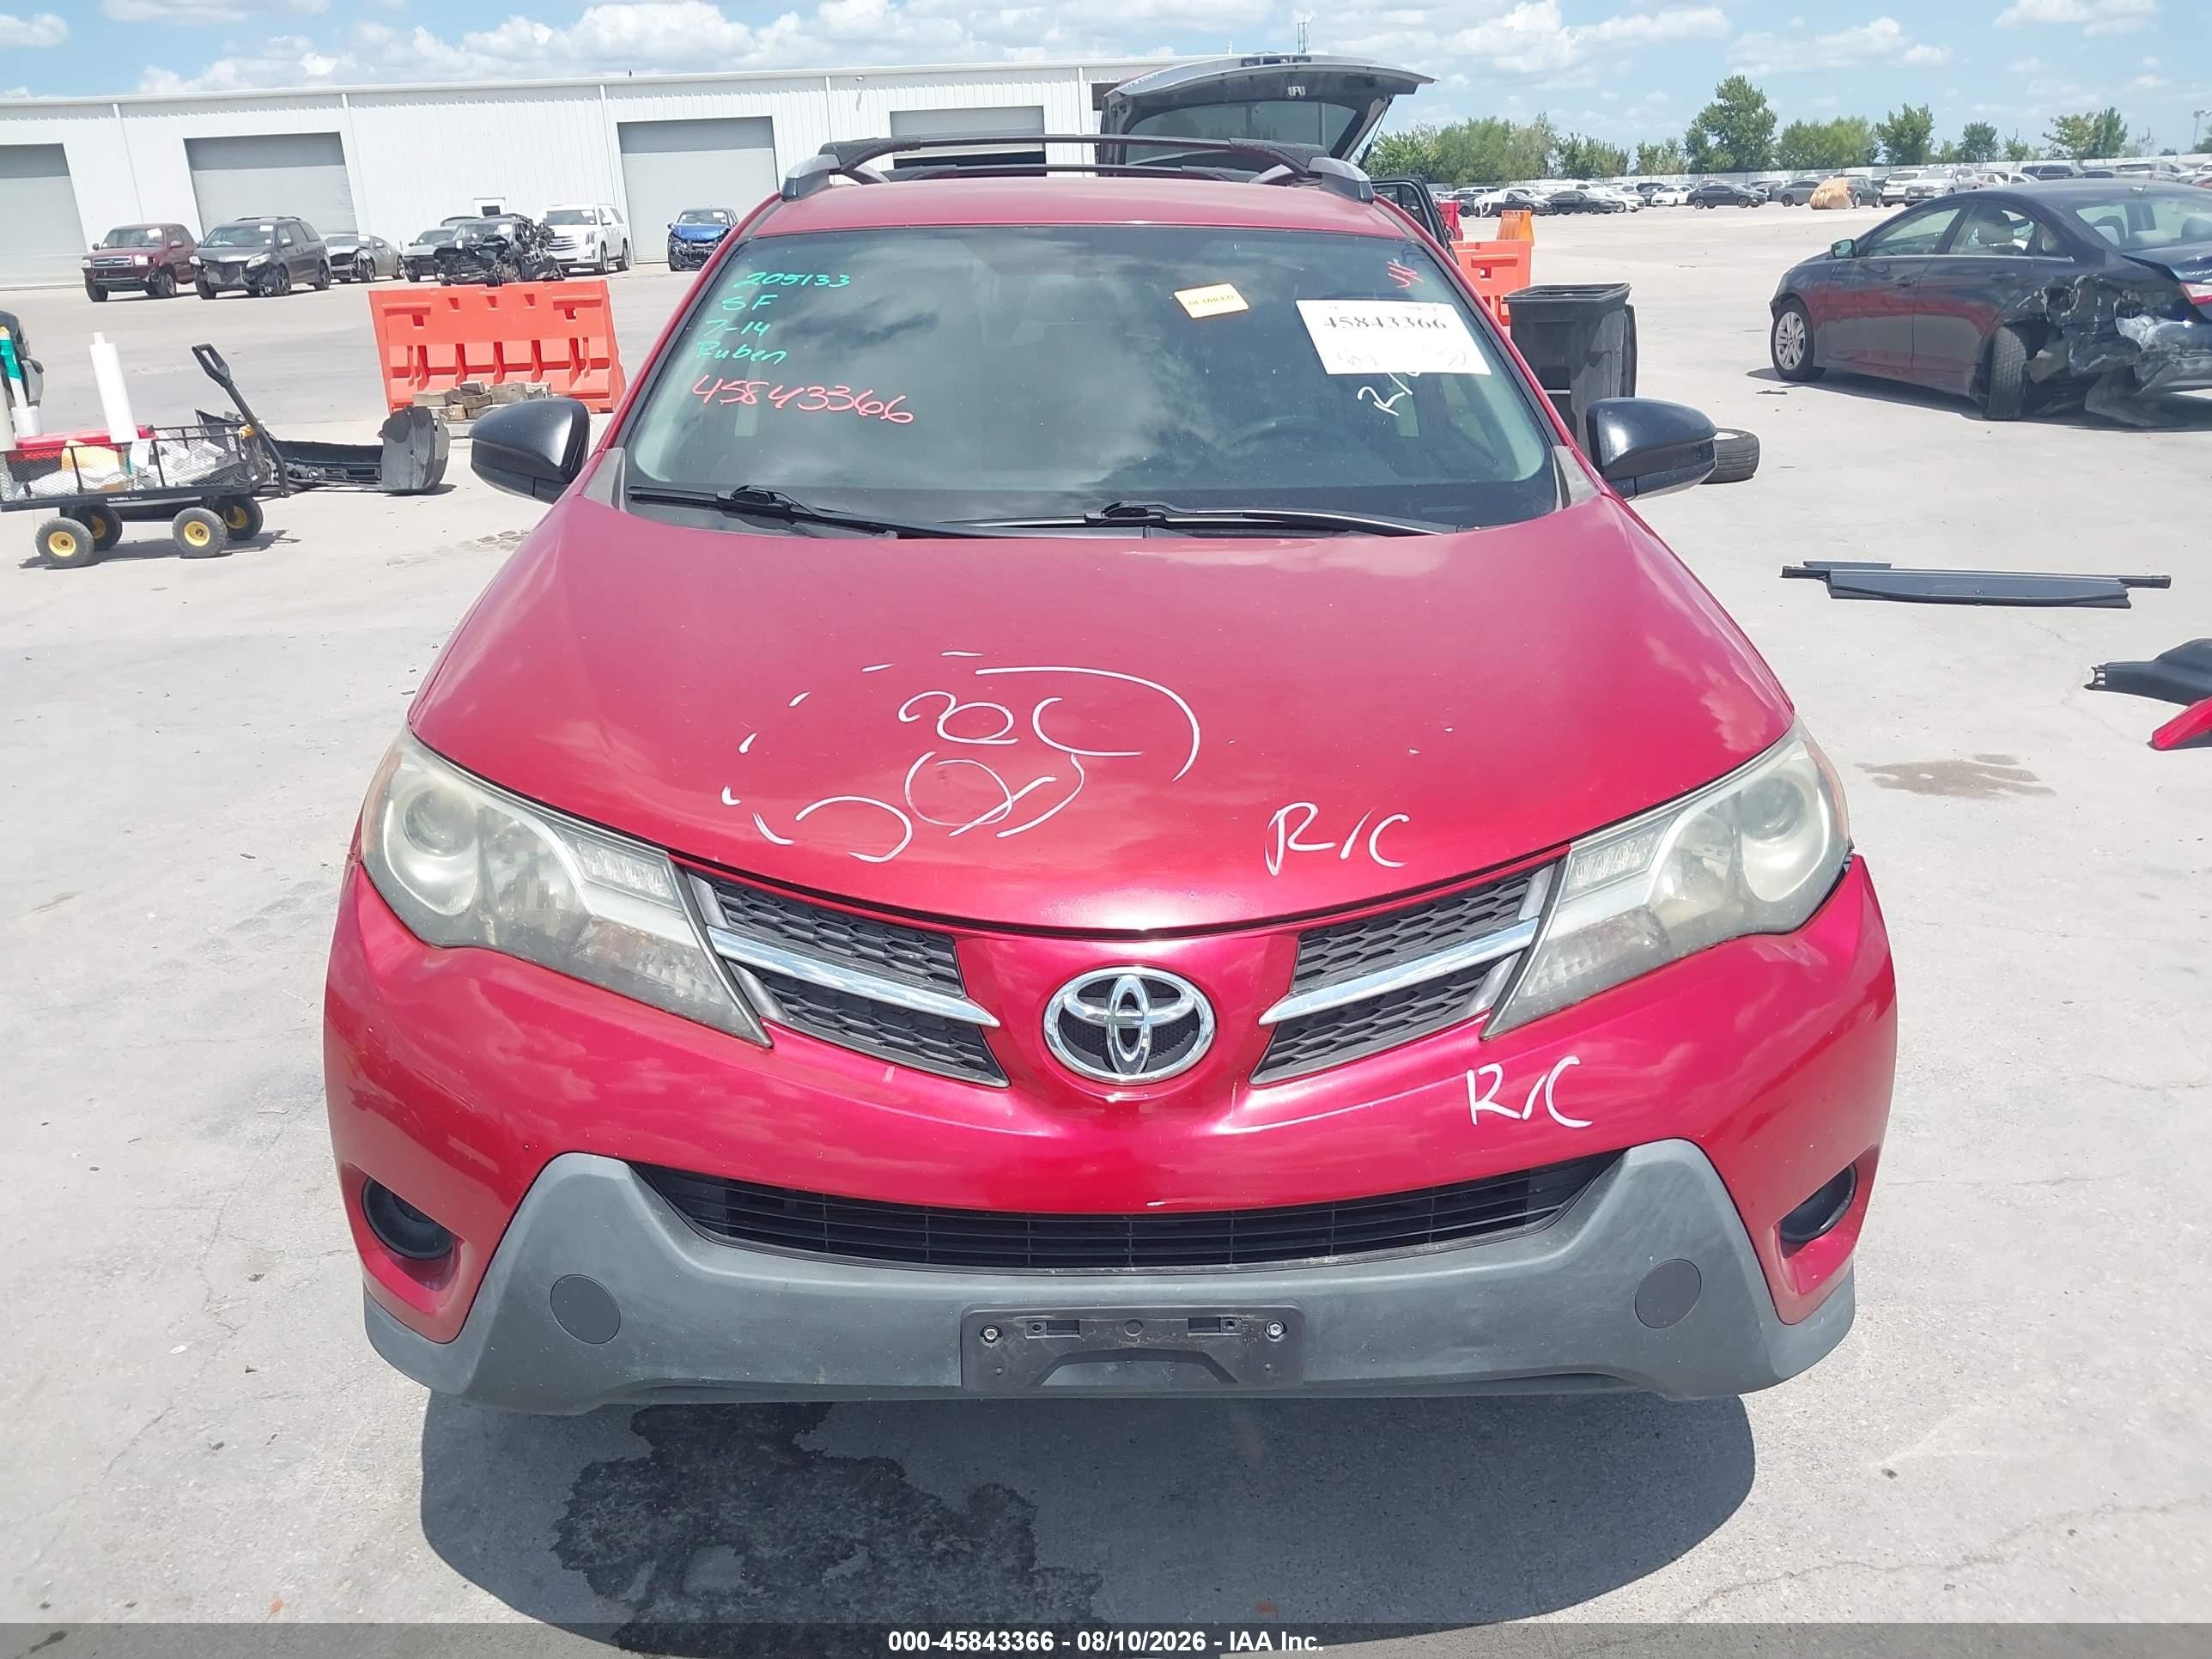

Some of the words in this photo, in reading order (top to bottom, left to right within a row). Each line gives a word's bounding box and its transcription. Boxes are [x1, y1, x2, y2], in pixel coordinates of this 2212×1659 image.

[733, 271, 852, 289] 205133
[703, 320, 771, 337] 7-14
[1323, 316, 1448, 329] 45843366
[696, 341, 788, 365] Ruben
[692, 374, 915, 424] 45843366
[1465, 1054, 1594, 1128] R/C
